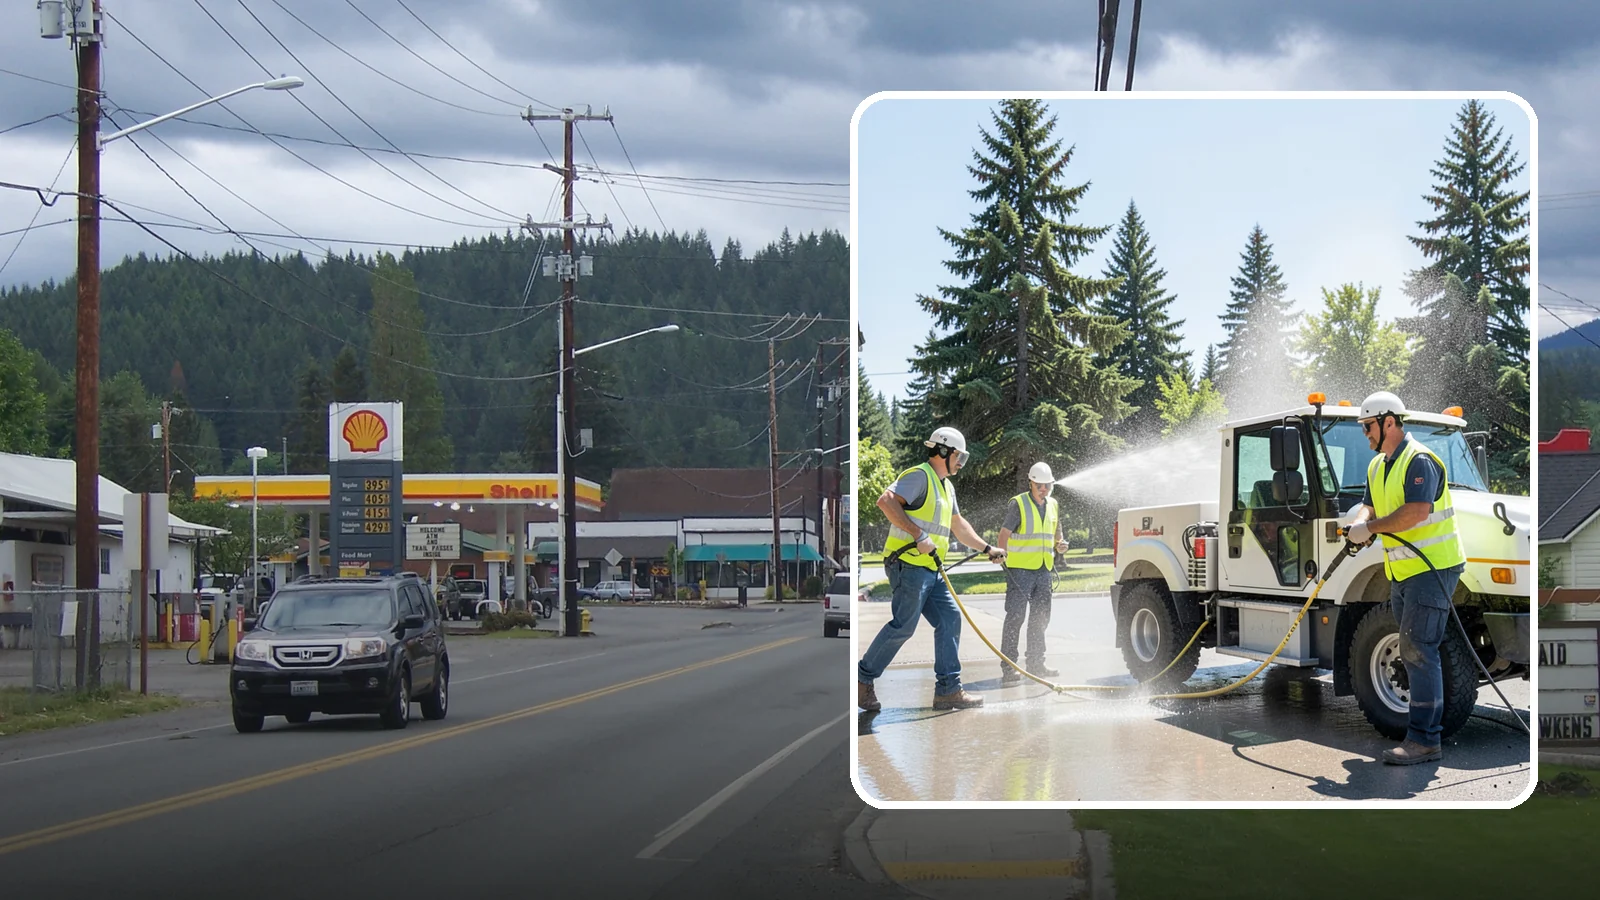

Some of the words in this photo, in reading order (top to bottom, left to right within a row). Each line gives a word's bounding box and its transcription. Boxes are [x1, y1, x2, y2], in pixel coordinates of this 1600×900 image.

[366, 480, 384, 491] 395
[490, 484, 547, 498] Shell
[366, 494, 384, 505] 405
[366, 508, 384, 518] 415
[366, 522, 384, 533] 429
[1538, 716, 1592, 738] WKENS
